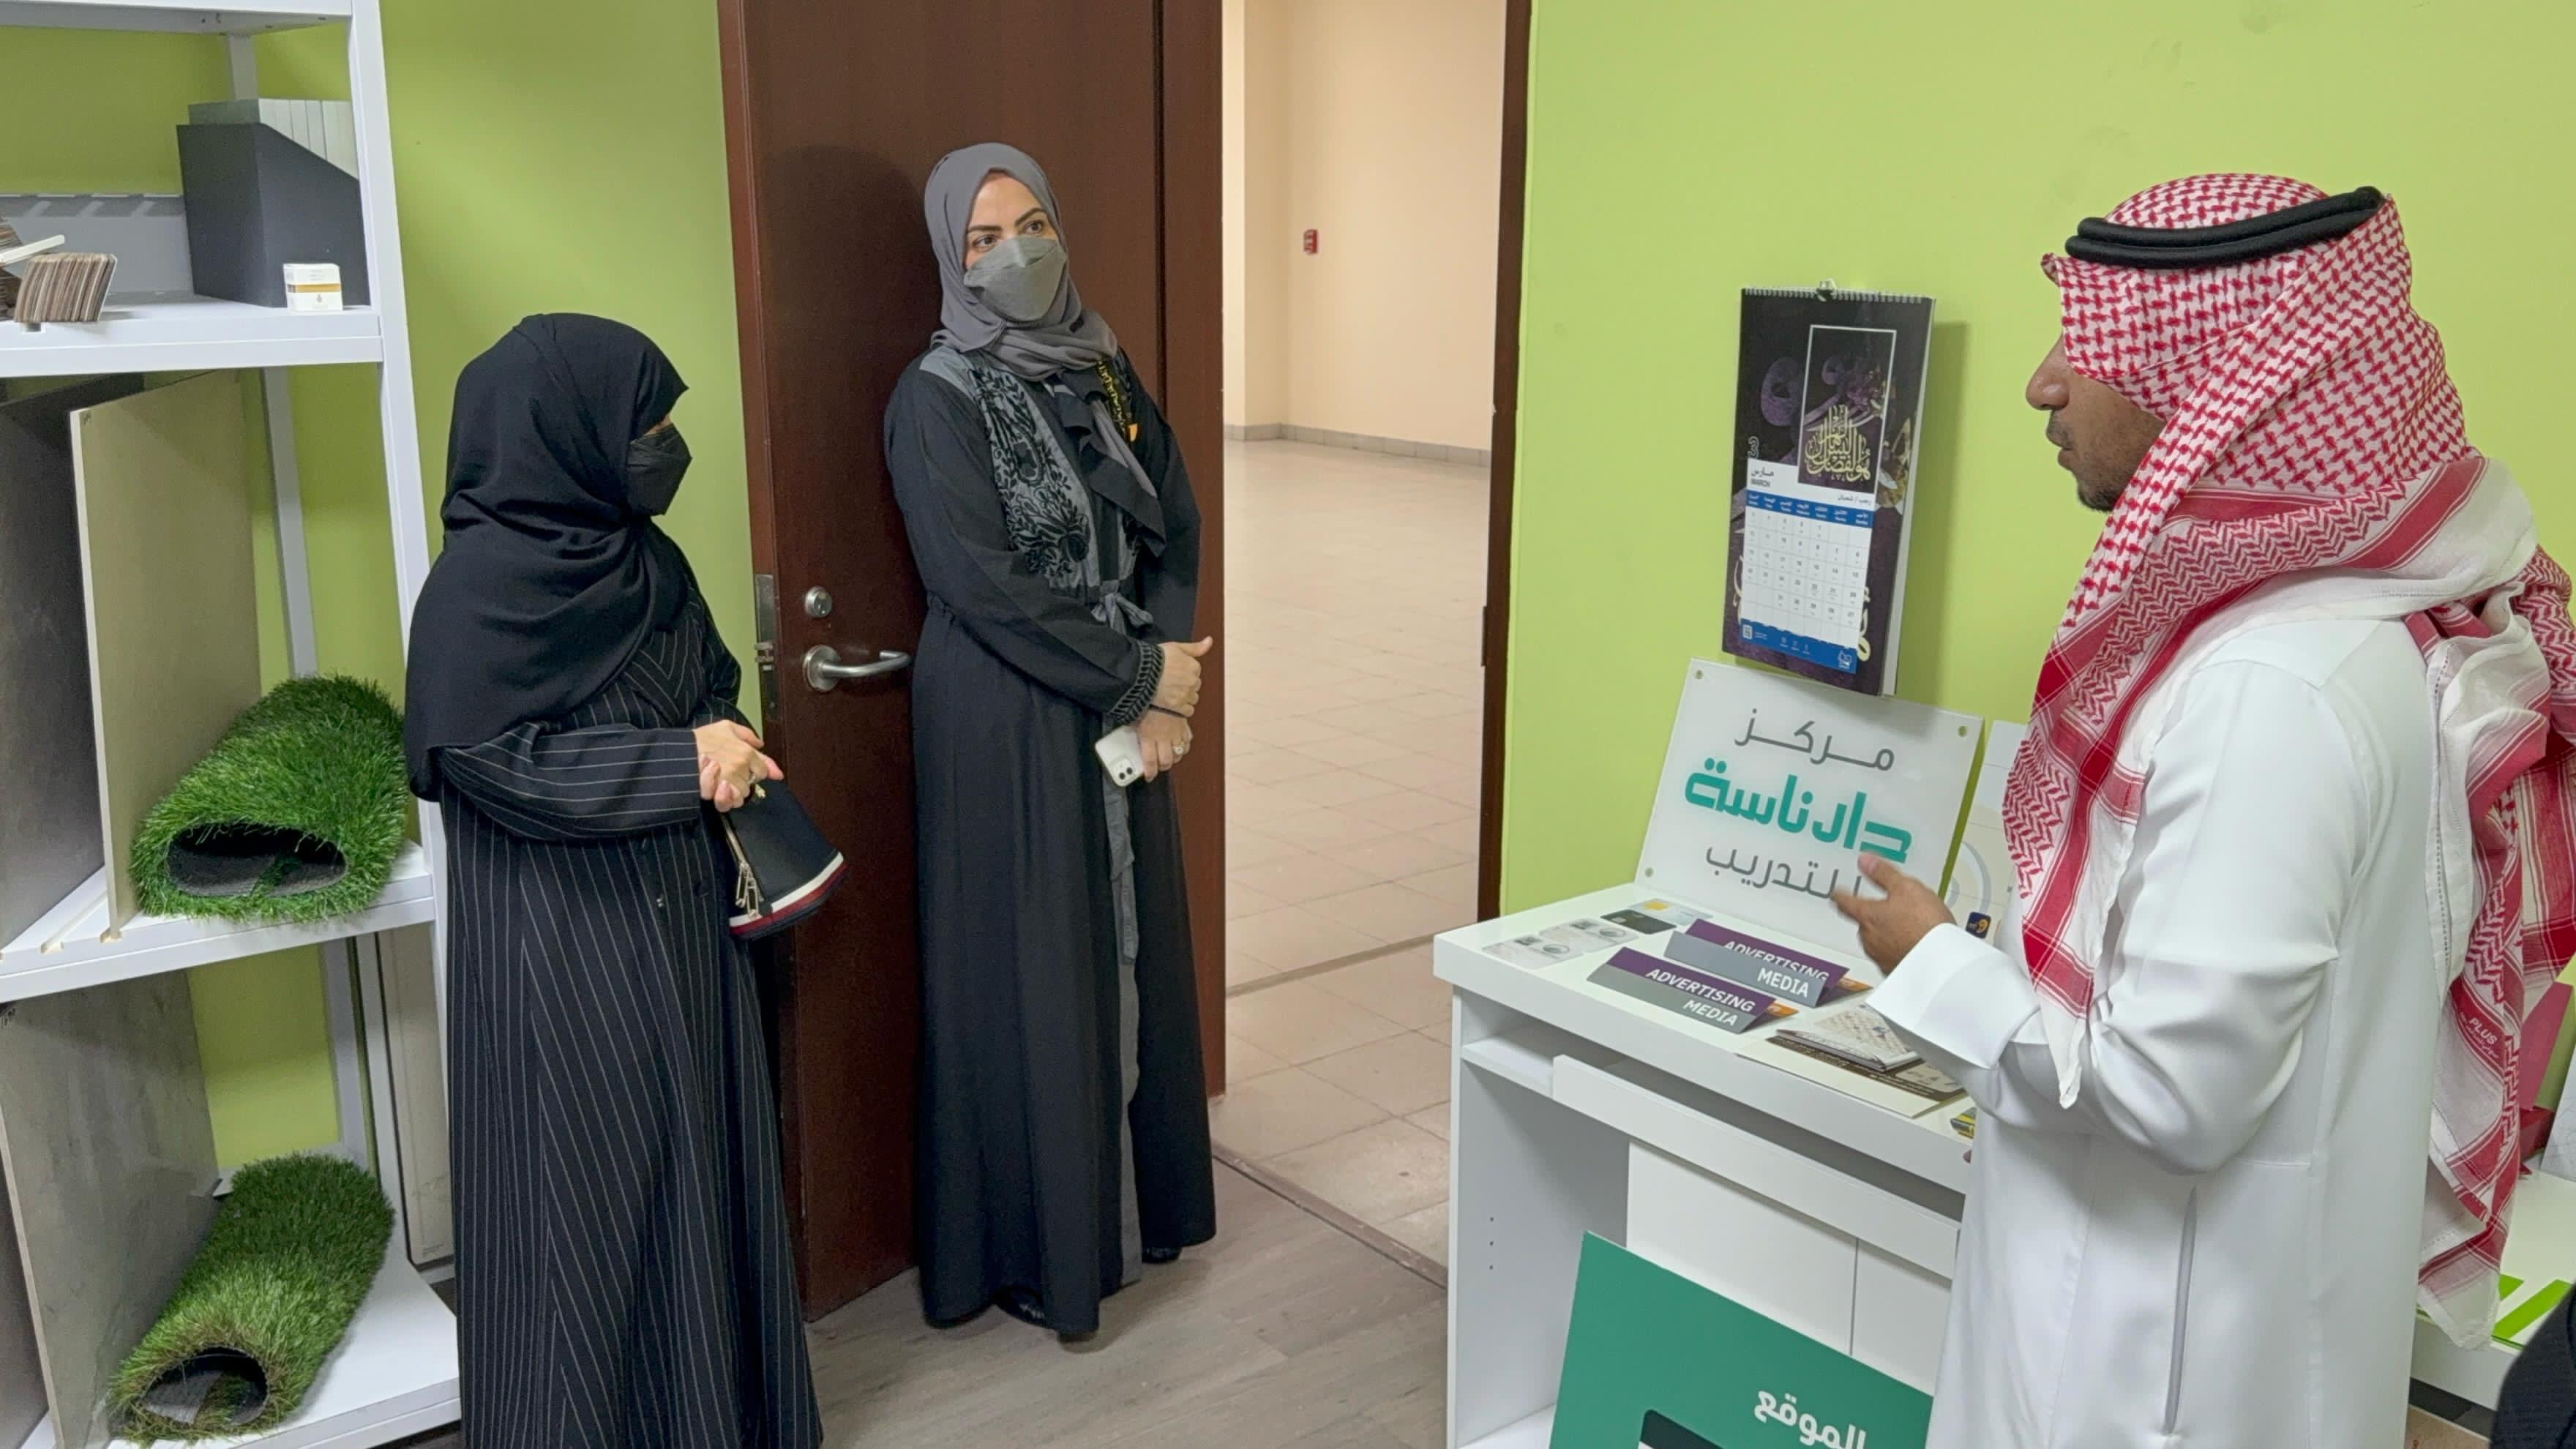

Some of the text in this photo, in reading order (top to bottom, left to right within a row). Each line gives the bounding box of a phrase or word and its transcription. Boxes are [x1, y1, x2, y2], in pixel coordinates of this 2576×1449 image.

[1751, 466, 1775, 477] مارس
[1734, 708, 1895, 771] مركز
[1724, 940, 1830, 982] ADVERTISING
[1646, 968, 1756, 1014] ADVERTISING
[1757, 967, 1809, 998] MEDIA
[1682, 1000, 1740, 1027] MEDIA
[2469, 1017, 2498, 1044] PLUS
[1754, 1390, 1866, 1449] الموقع
